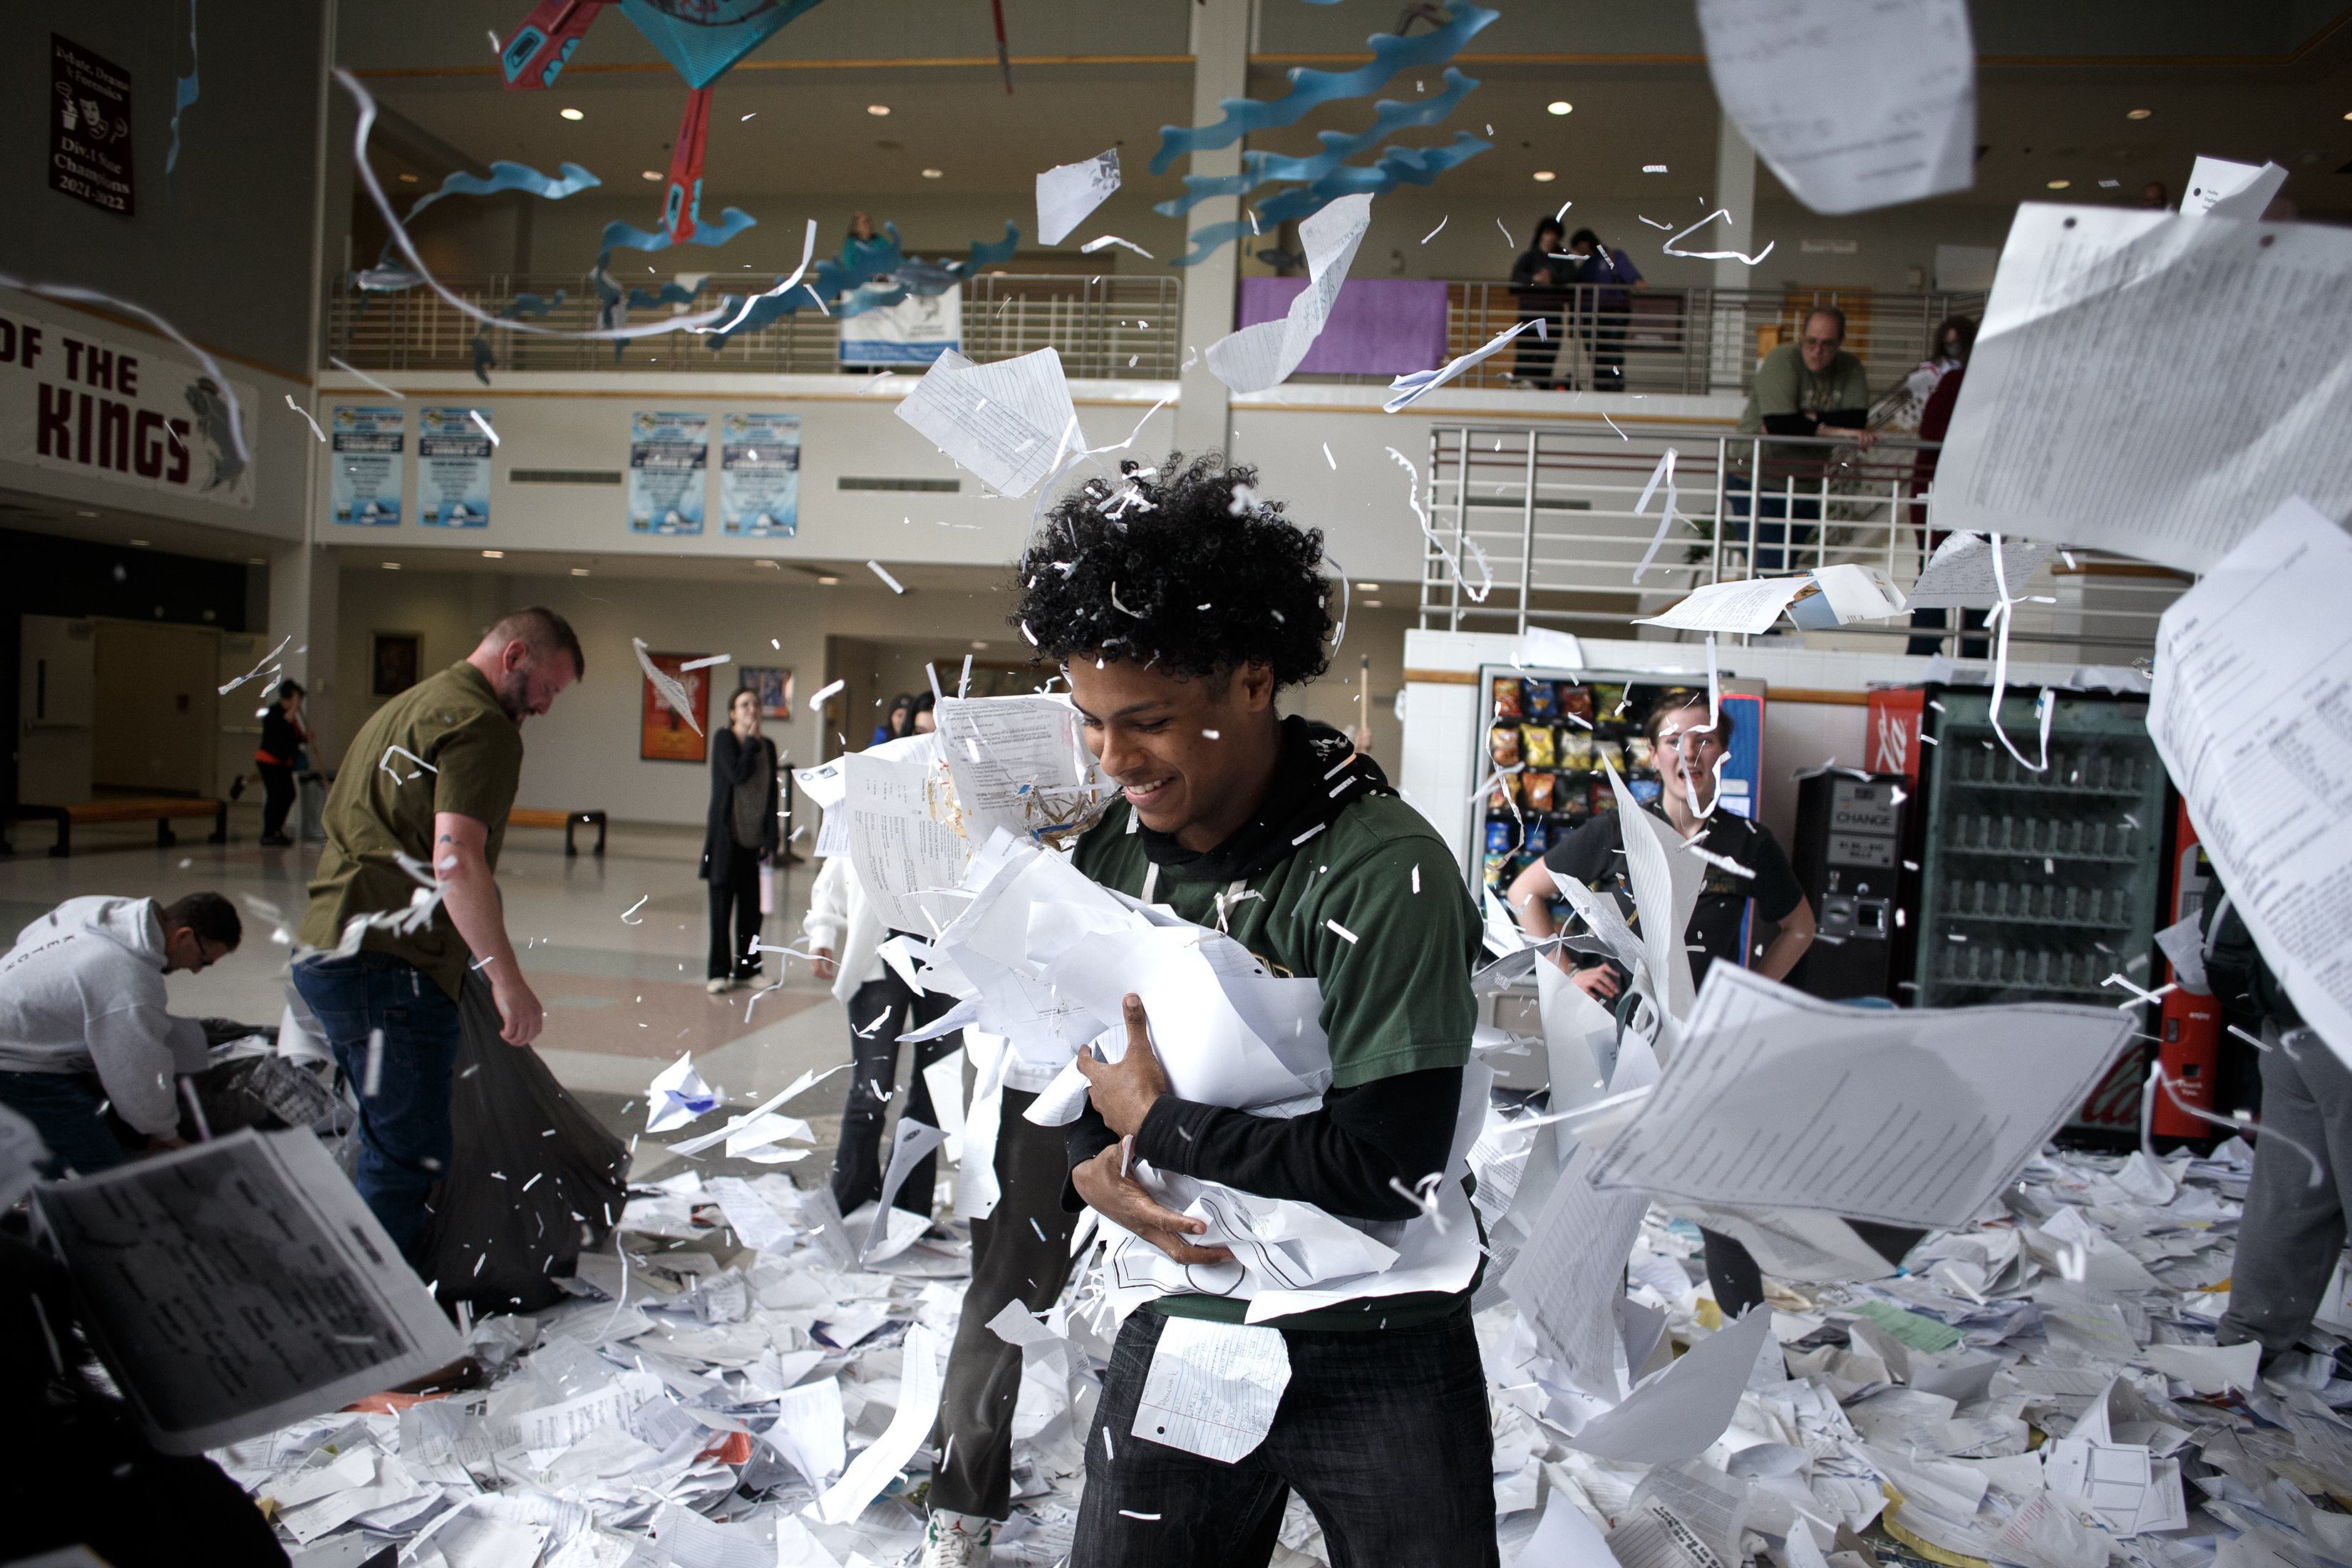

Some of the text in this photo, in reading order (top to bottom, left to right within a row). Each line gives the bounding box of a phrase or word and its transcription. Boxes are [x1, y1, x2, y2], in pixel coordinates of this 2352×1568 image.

[75, 70, 123, 101] Forensics
[96, 67, 130, 91] Drama
[54, 153, 130, 194] Champions
[59, 175, 125, 210] 2021-2022
[63, 337, 138, 398] THE
[38, 382, 190, 485] KINGS
[1837, 811, 1891, 827] CHANGE
[1158, 1370, 1179, 1406] Homework
[1659, 1506, 1698, 1547] Learning
[1699, 1547, 1710, 1558] to
